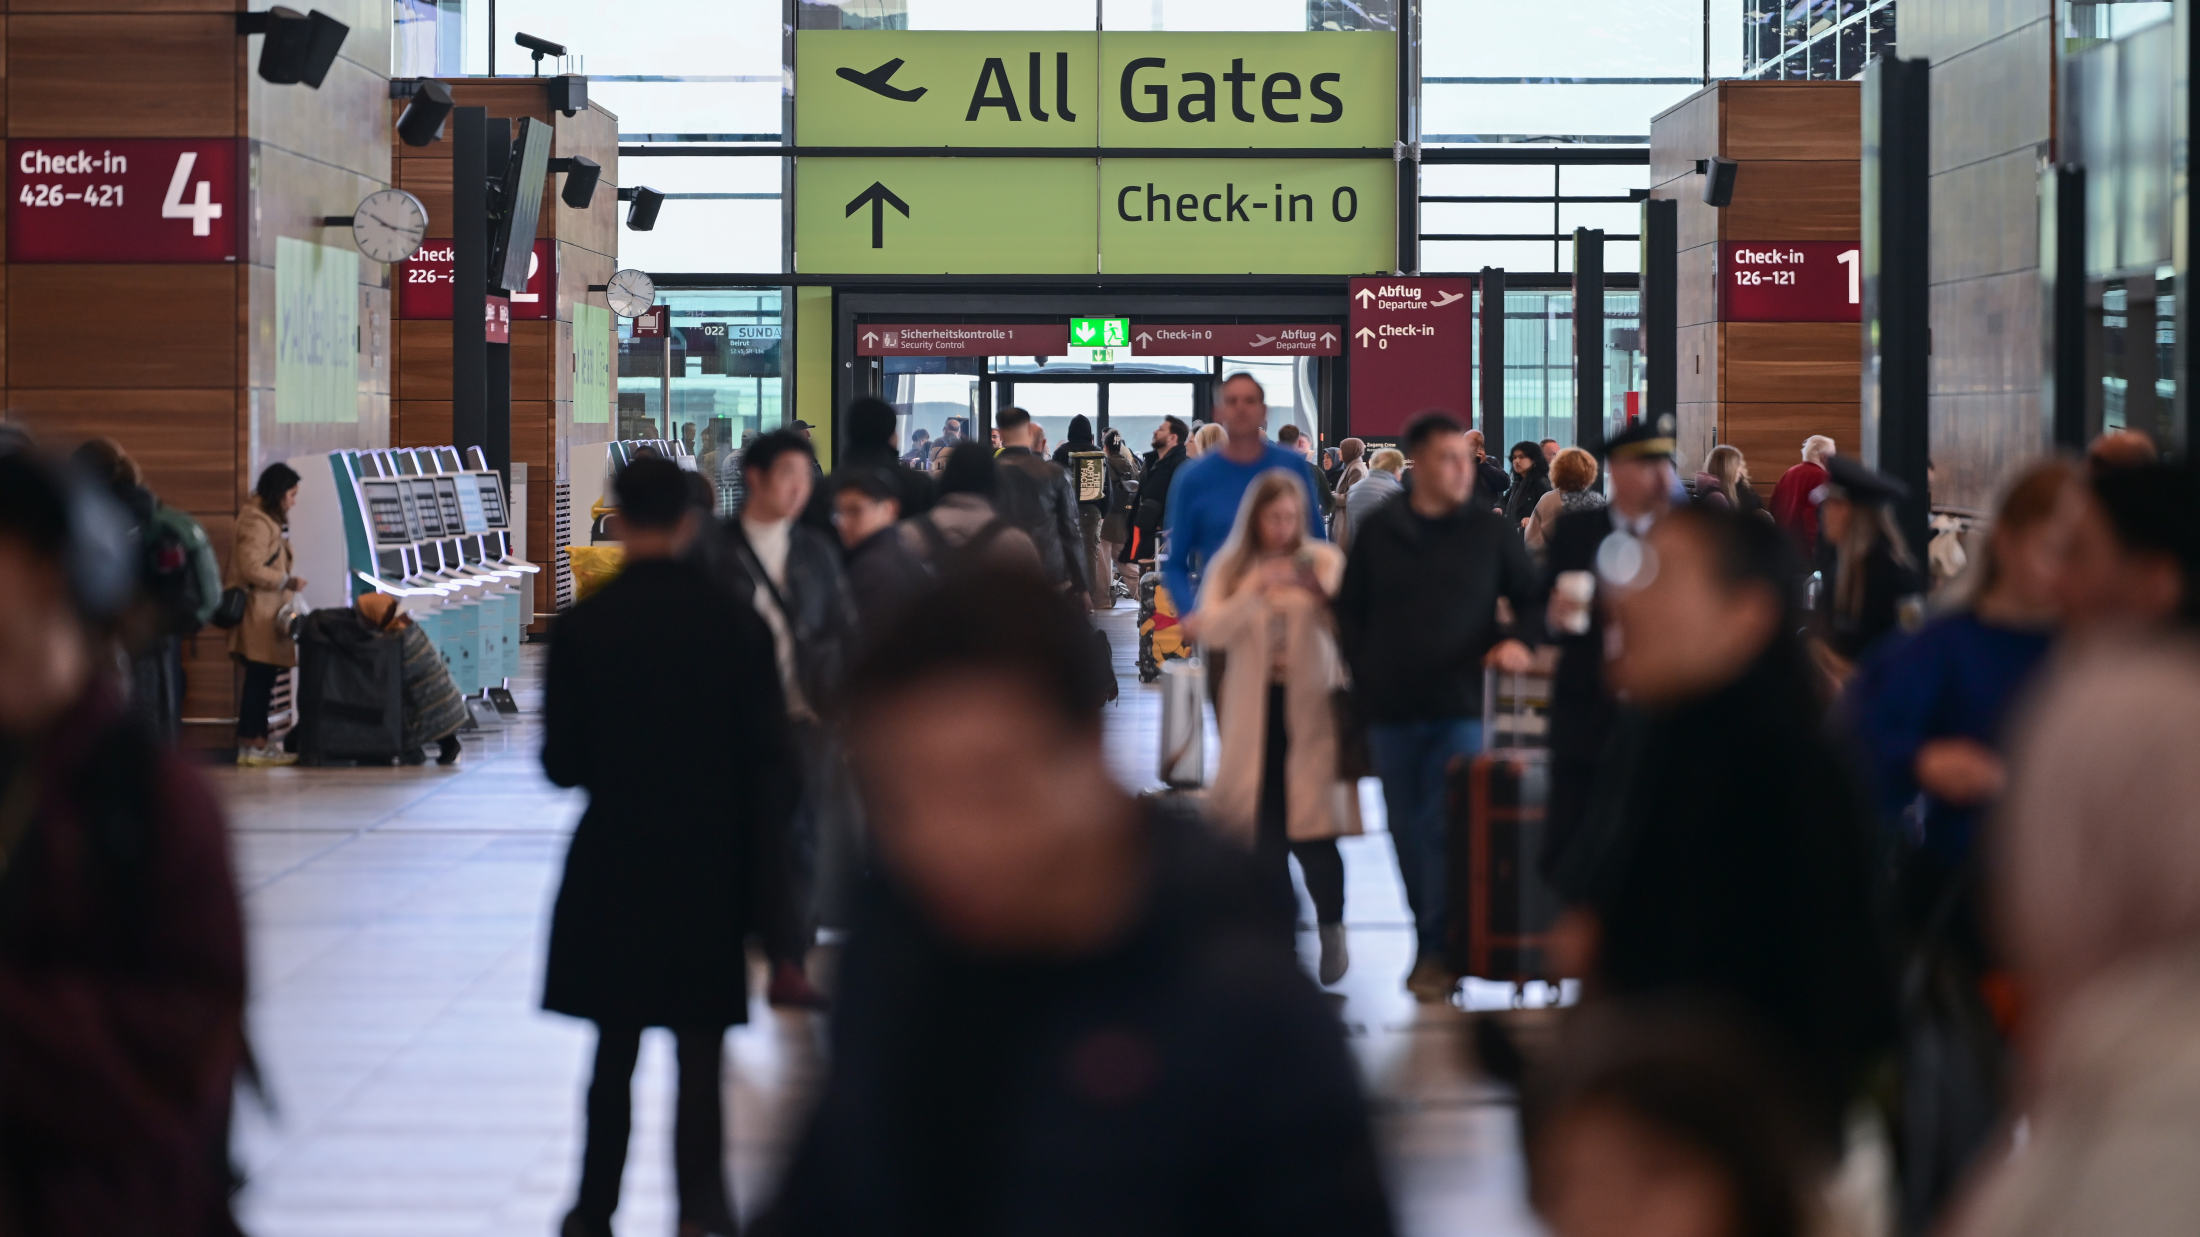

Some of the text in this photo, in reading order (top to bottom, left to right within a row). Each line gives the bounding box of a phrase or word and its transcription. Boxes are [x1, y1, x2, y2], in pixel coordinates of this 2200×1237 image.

[964, 51, 1344, 124] All Gates
[20, 149, 127, 174] Check-in
[20, 183, 124, 207] 426–421
[161, 151, 223, 237] 4
[1117, 182, 1358, 223] Check-in 0
[1735, 248, 1805, 264] Check-in
[1734, 270, 1795, 286] 126–121
[1836, 249, 1860, 304] 1
[1377, 284, 1421, 300] Abflug
[1378, 300, 1428, 311] Departure
[704, 326, 724, 336] 022
[900, 329, 1013, 339] Sicherheitskontrolle 1
[1156, 329, 1212, 340] Check-in 0
[1280, 329, 1316, 342] Abflug
[1378, 324, 1434, 336] Check-in
[901, 340, 965, 351] Security Control
[1276, 341, 1317, 351] Departure
[1378, 339, 1388, 350] 0
[1086, 460, 1094, 487] NORTH
